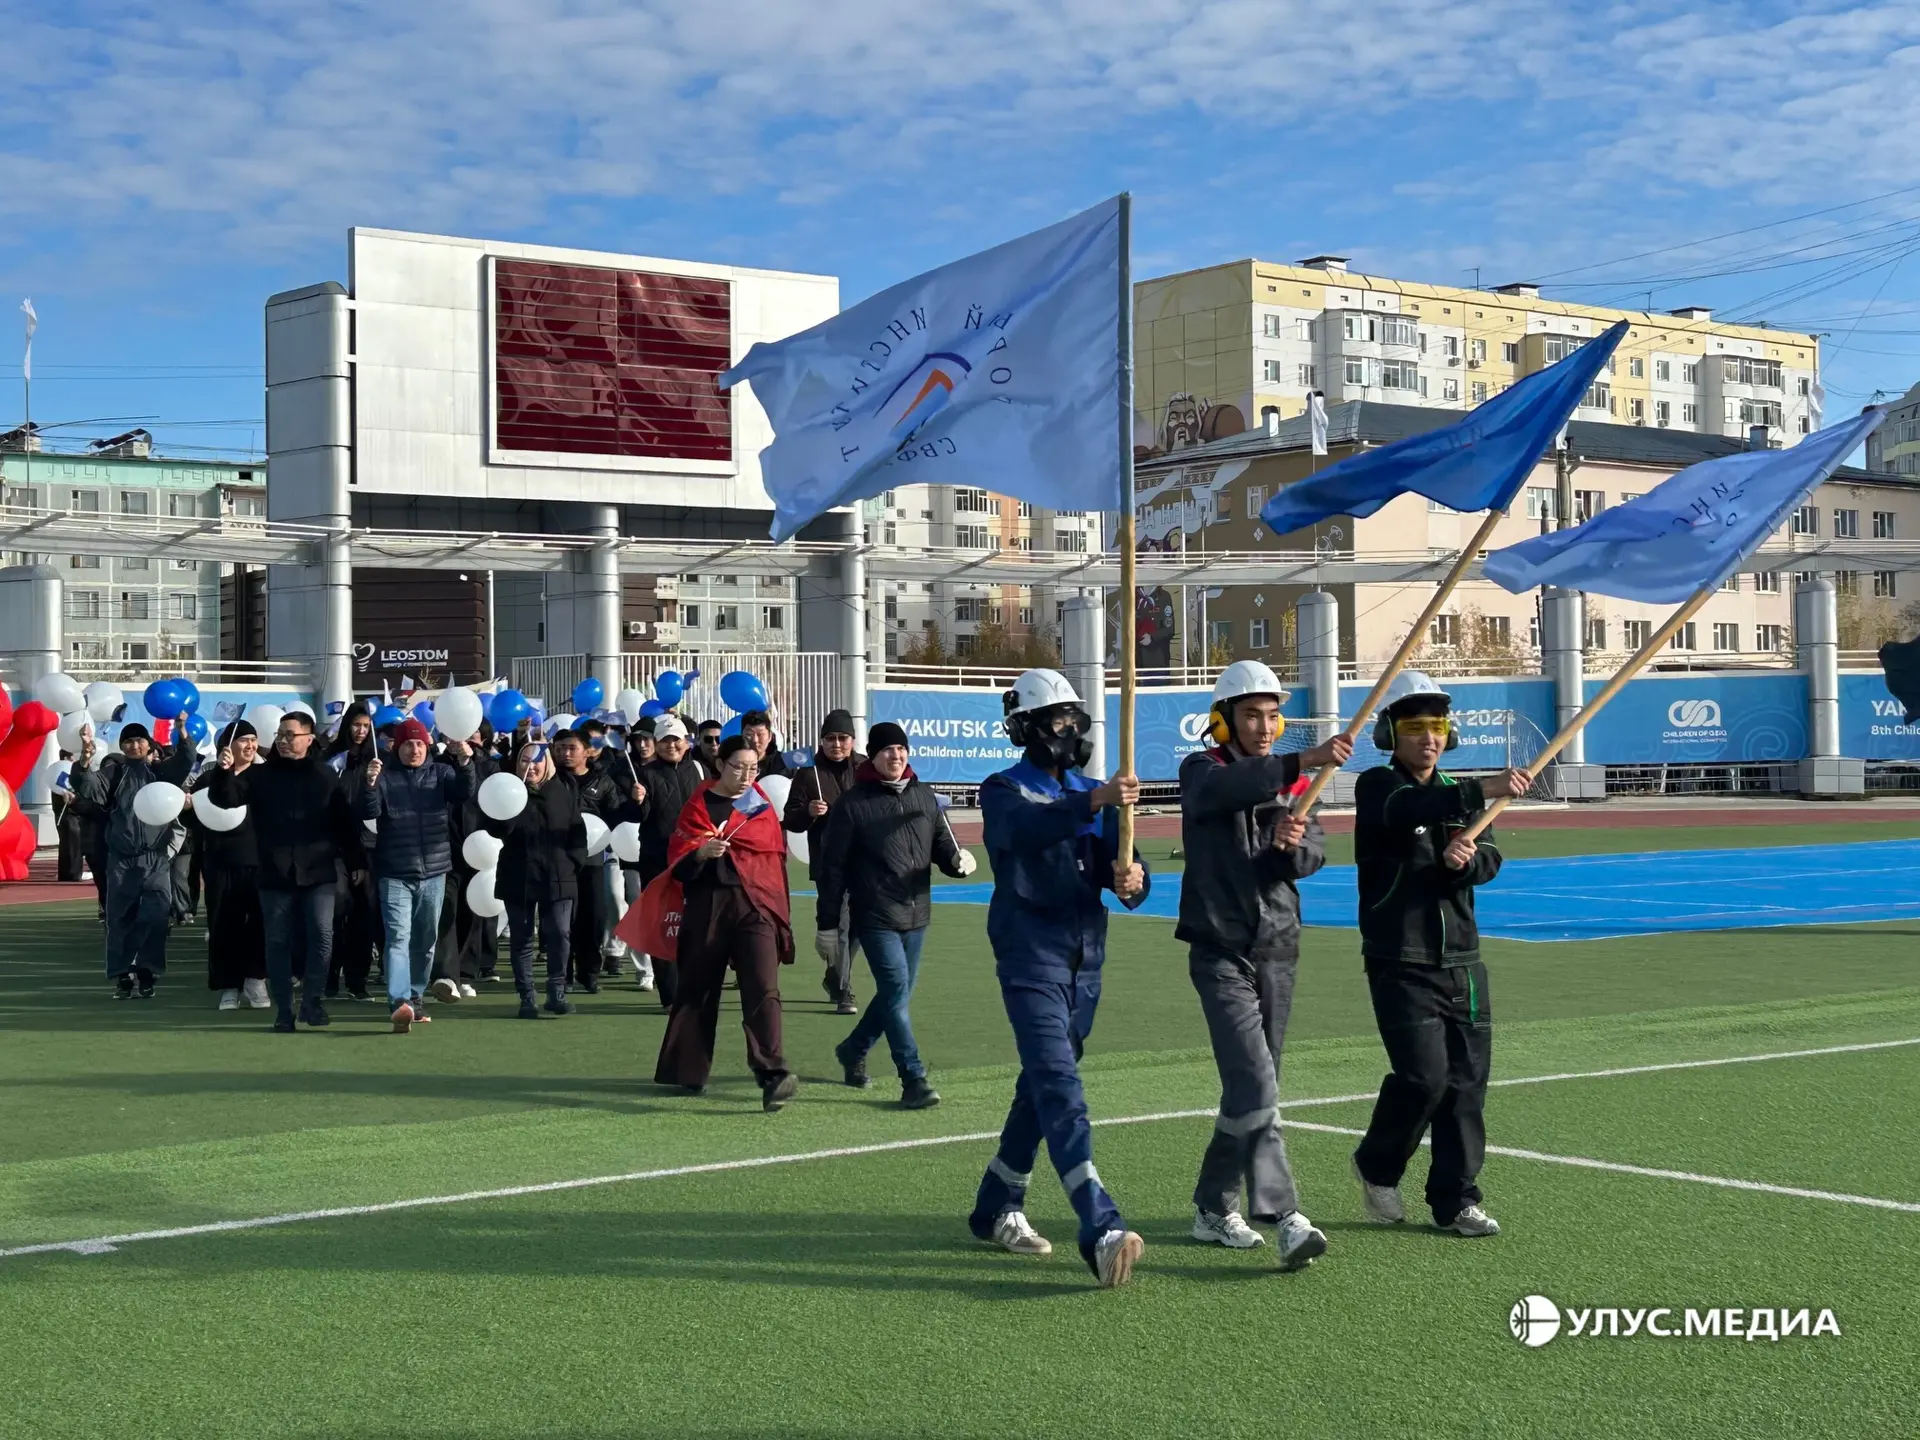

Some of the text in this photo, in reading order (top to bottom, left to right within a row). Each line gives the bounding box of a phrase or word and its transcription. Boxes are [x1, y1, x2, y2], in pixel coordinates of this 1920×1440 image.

[381, 649, 449, 661] LEOSTOM
[896, 719, 988, 738] YAKUTSK
[1871, 725, 1892, 735] 8th
[919, 745, 964, 757] Children
[966, 747, 978, 758] of
[980, 747, 1003, 758] Asia
